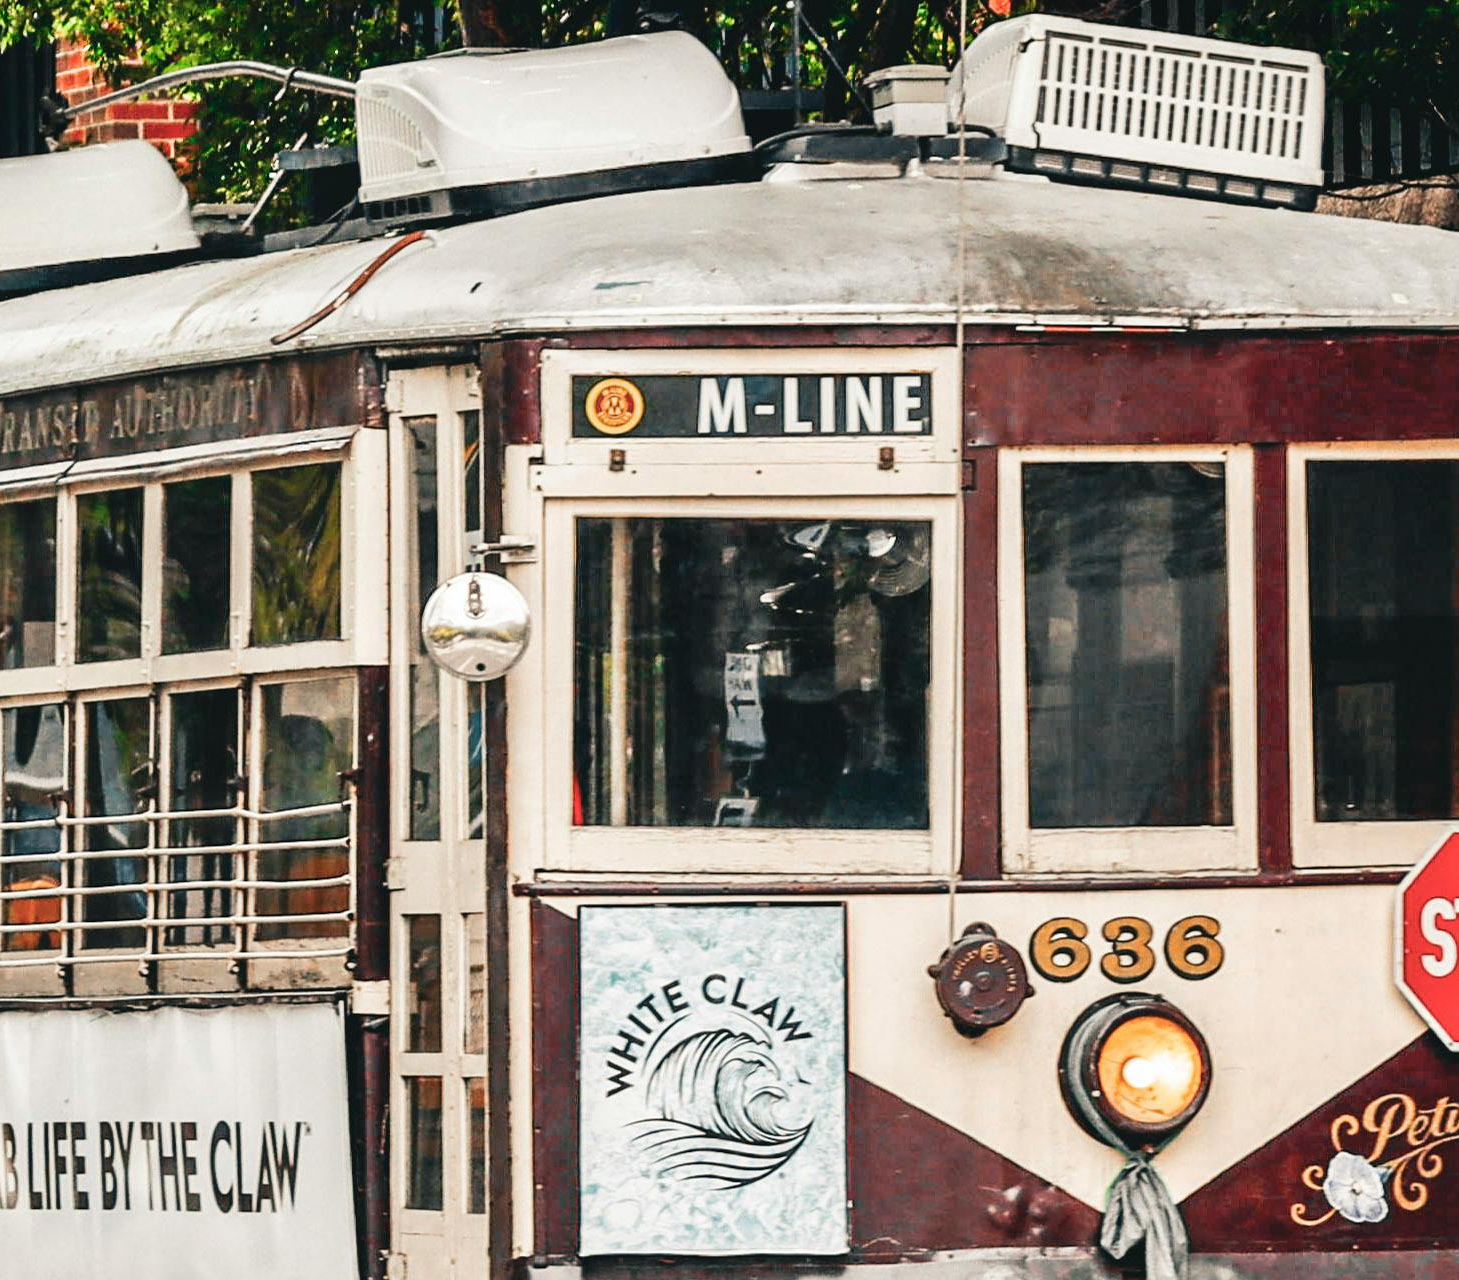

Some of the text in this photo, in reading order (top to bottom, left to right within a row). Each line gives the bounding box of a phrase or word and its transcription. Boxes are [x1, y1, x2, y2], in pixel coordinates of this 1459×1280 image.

[697, 376, 923, 434] M-LINE
[1029, 916, 1226, 983] 636
[606, 973, 813, 1097] WHITE CLAW
[27, 1121, 89, 1210] LIFE
[100, 1121, 134, 1210] BY
[141, 1121, 201, 1211] THE
[209, 1120, 302, 1213] CLAW
